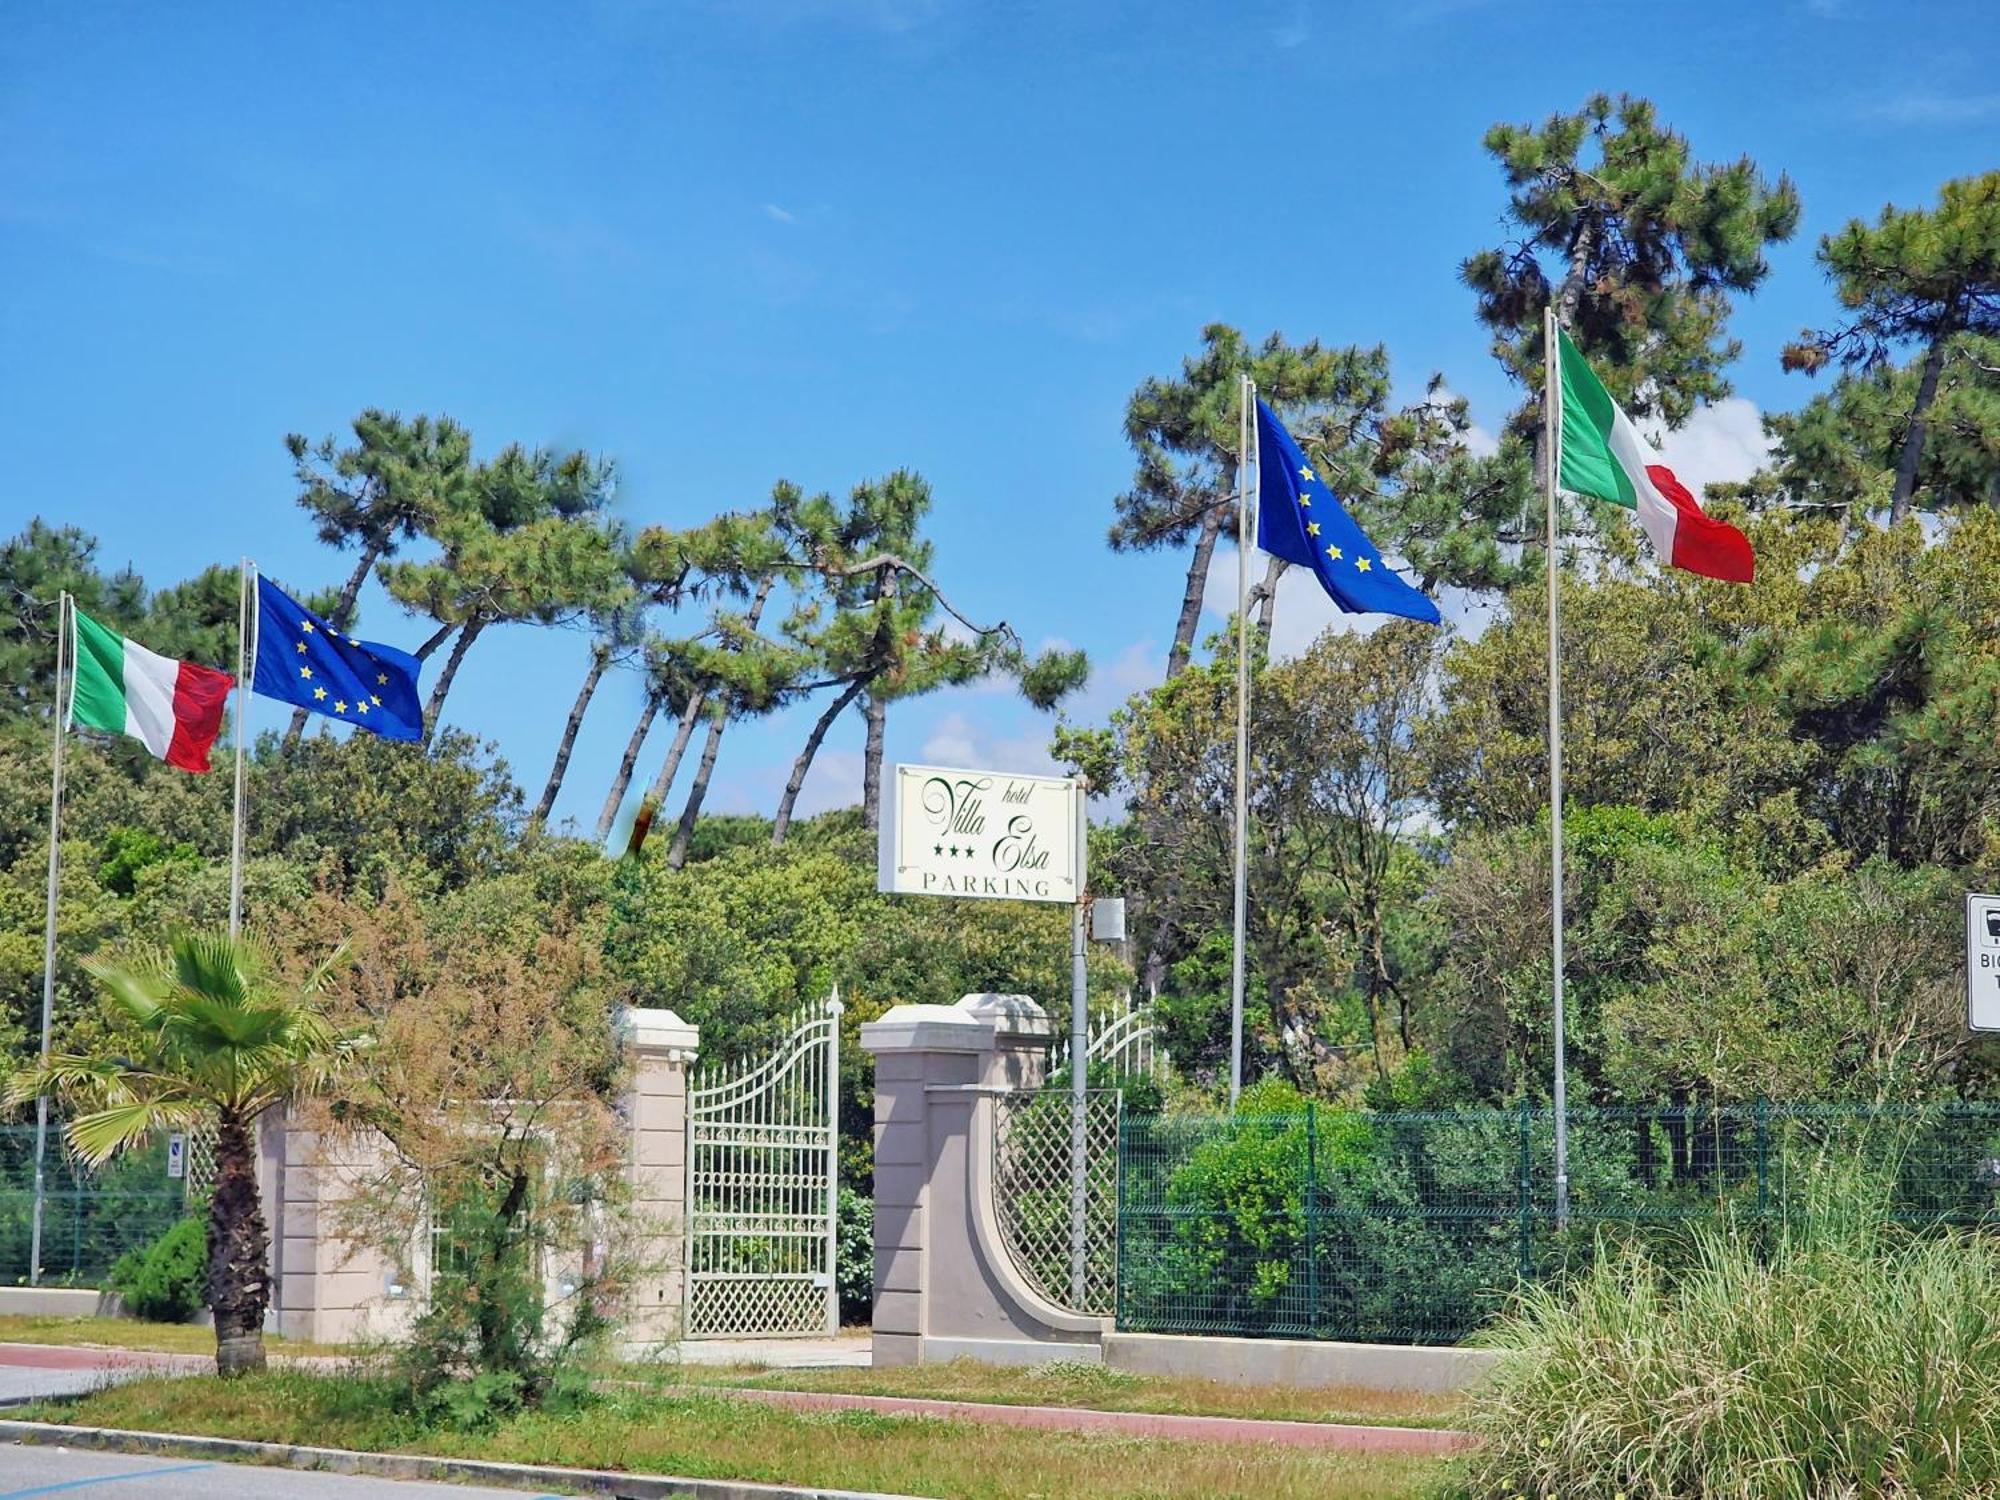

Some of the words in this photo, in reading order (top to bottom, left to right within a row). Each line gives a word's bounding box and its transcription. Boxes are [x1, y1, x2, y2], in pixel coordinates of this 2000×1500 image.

[1002, 780, 1035, 805] hotel
[921, 777, 994, 836] Villa
[992, 815, 1050, 873] Elsa
[923, 872, 1050, 897] PARKING
